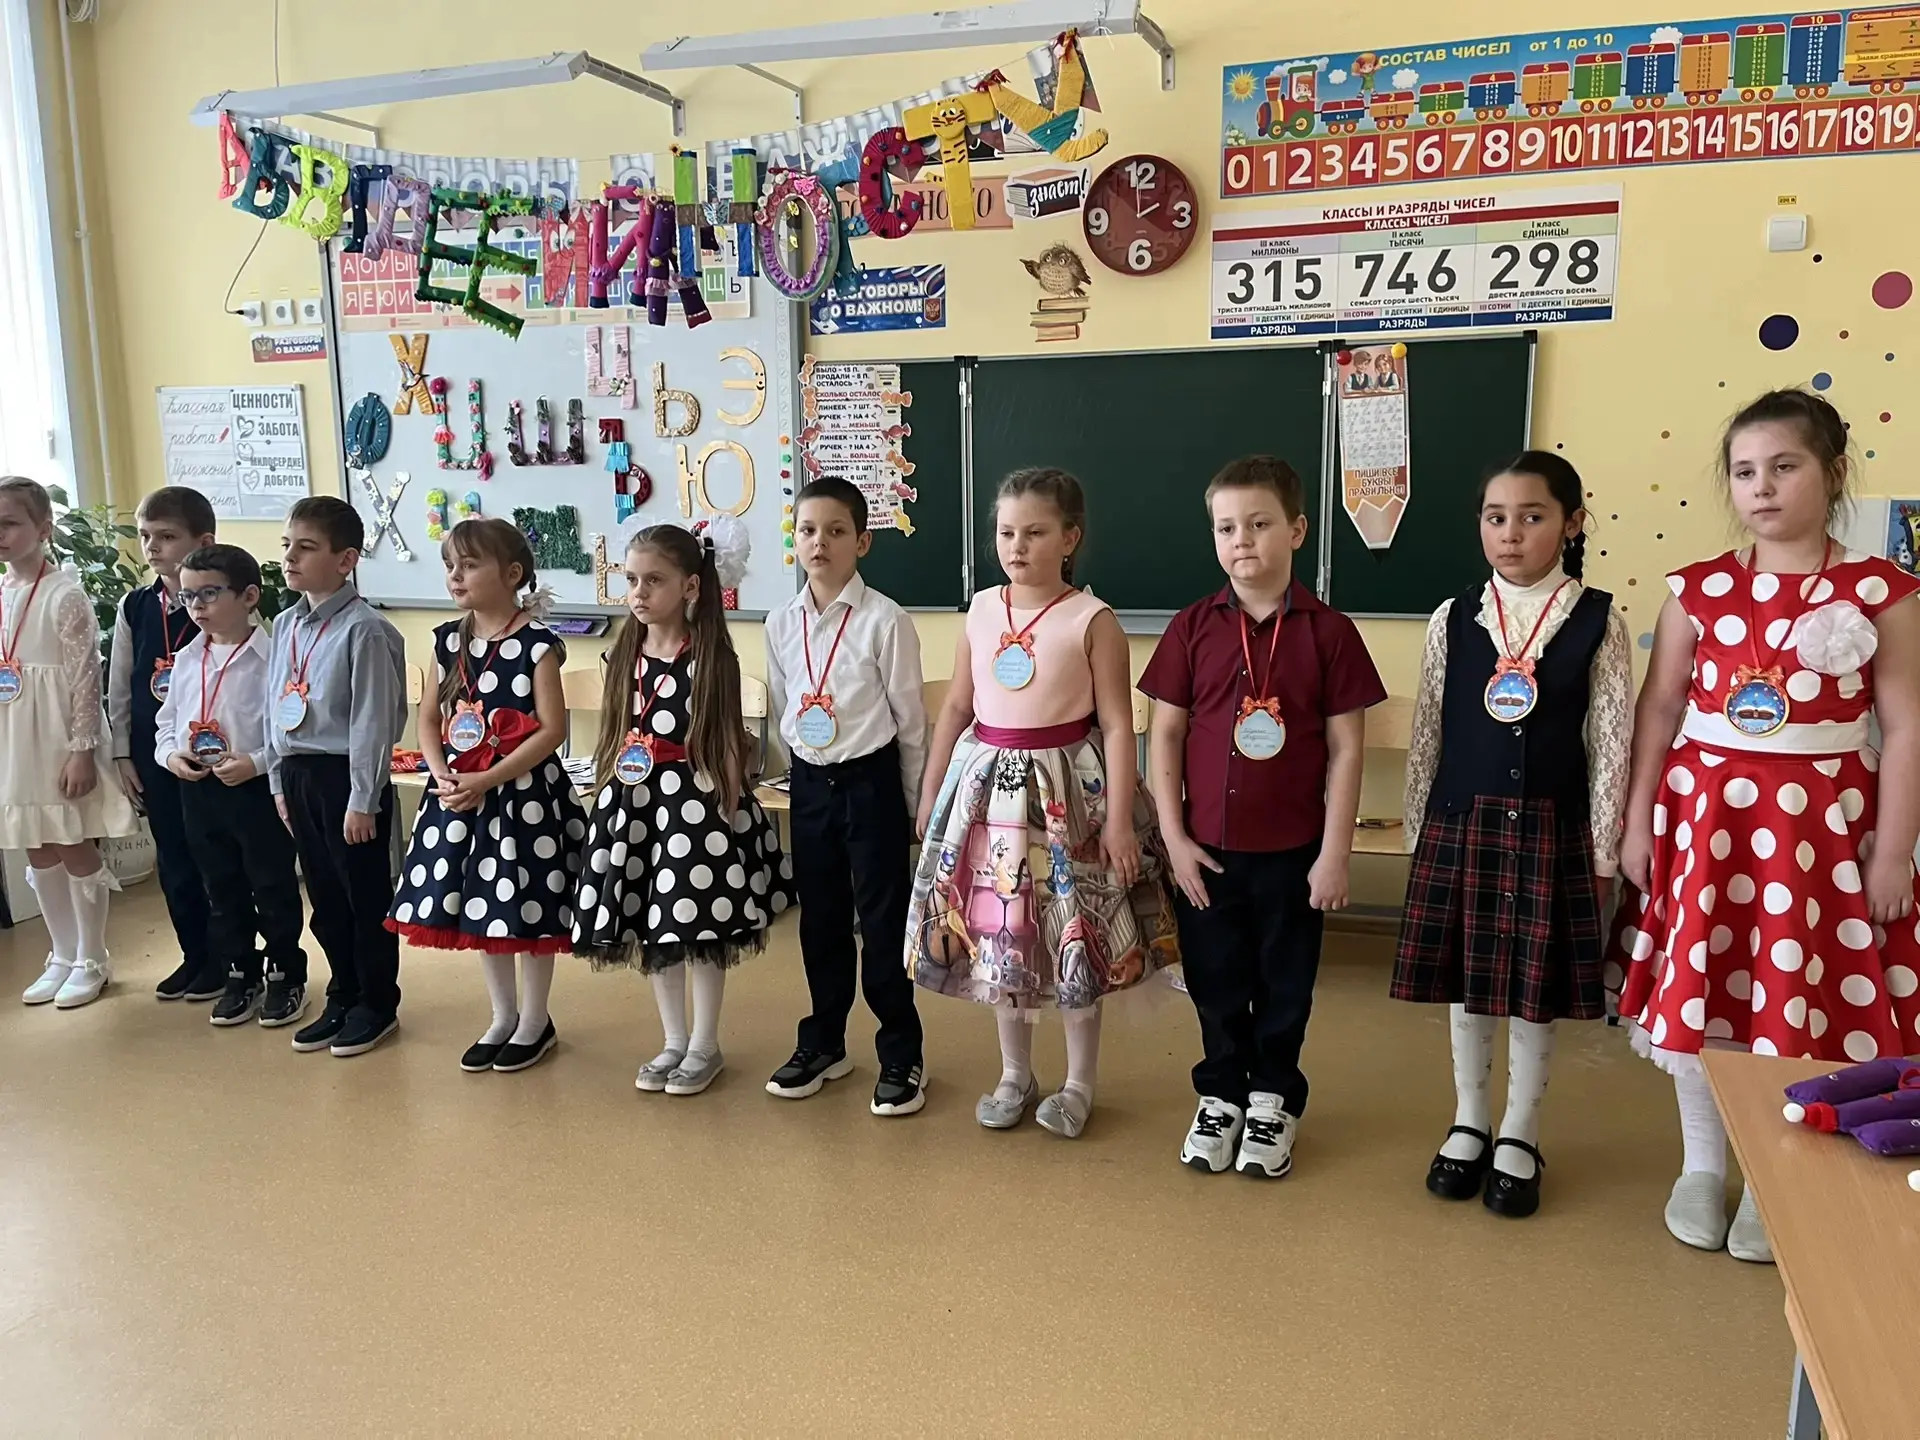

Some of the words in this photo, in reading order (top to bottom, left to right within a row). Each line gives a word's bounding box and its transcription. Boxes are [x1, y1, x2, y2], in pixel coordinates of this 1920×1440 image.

[1811, 16, 1823, 24] 10
[1757, 26, 1764, 34] 9
[1702, 34, 1709, 43] 8
[1379, 49, 1446, 67] СОСТАВ
[1452, 42, 1511, 59] ЧИСЕЛ
[1529, 41, 1548, 52] от
[1553, 38, 1560, 51] 1
[1567, 37, 1587, 50] до
[1594, 33, 1613, 46] 10
[1648, 45, 1655, 53] 7
[1227, 154, 1250, 189] 0
[1263, 151, 1278, 187] 1
[1289, 148, 1311, 185] 2
[1320, 144, 1343, 182] 3
[1350, 142, 1376, 179] 4
[1384, 139, 1408, 177] 5
[1416, 135, 1441, 173] 6
[1451, 133, 1475, 171] 7
[1483, 129, 1510, 168] 8
[1518, 126, 1545, 166] 9
[1551, 124, 1582, 163] 10
[1587, 121, 1618, 160] 11
[1622, 119, 1653, 158] 12
[1657, 117, 1689, 156] 13
[1693, 115, 1725, 154] 14
[1729, 112, 1762, 152] 15
[1766, 110, 1799, 149] 16
[1802, 108, 1838, 148] 17
[1840, 105, 1875, 145] 18
[1878, 103, 1914, 143] 19
[1125, 161, 1156, 190] 12
[757, 166, 840, 301] О
[859, 126, 930, 239] С
[903, 91, 997, 231] Т
[1322, 206, 1373, 220] КЛАССЫ
[1376, 206, 1385, 215] И
[1388, 200, 1450, 215] РАЗРЯДЫ
[1453, 197, 1496, 210] ЧИСЕЛ
[1088, 207, 1109, 235] 9
[1172, 201, 1191, 228] 3
[1365, 217, 1410, 230] КЛАССЫ
[1412, 215, 1449, 227] ЧИСЕЛ
[1536, 220, 1561, 228] класс
[1399, 230, 1422, 238] класс
[1522, 228, 1569, 239] ЕДИНИЦЫ
[1269, 239, 1290, 247] класс
[1389, 238, 1424, 248] ТЫСЯЧИ
[1128, 239, 1152, 270] 6
[1251, 247, 1299, 257] МИЛЛИОНЫ
[343, 259, 355, 274] А
[360, 258, 372, 273] О
[395, 256, 409, 271] Ы
[1489, 239, 1599, 290] 298
[1354, 248, 1457, 299] 746
[707, 274, 724, 295] Щ
[1227, 257, 1322, 305] 315
[346, 292, 357, 308] Я
[379, 290, 394, 306] Ю
[1488, 292, 1517, 300] двести
[1519, 289, 1564, 298] девяносто
[1383, 298, 1406, 306] сорок
[1528, 300, 1562, 309] ДЕСЯТКИ
[1572, 297, 1610, 306] ЕДИНИЦЫ
[830, 306, 841, 317] О
[845, 299, 923, 317] ВАЖНОМ!
[1217, 307, 1242, 315] триста
[1244, 304, 1287, 313] пятнадцать
[1289, 302, 1331, 310] миллионов
[1390, 308, 1423, 317] ДЕСЯТКИ
[1433, 305, 1470, 314] ЕДИНИЦЫ
[1261, 315, 1292, 323] ДЕСЯТКИ
[1300, 313, 1334, 321] ЕДИНИЦЫ
[1515, 311, 1567, 322] РАЗРЯДЫ
[1379, 318, 1428, 329] РАЗРЯДЫ
[1250, 325, 1296, 335] РАЗРЯДЫ
[283, 345, 319, 353] ВАЖНОМ
[717, 347, 766, 426] Э
[232, 393, 293, 410] ЦЕННОСТИ
[653, 361, 700, 438] Ь
[258, 422, 299, 436] ЗАБОТА
[346, 392, 391, 465] Ф
[504, 397, 585, 467] Ш
[250, 457, 302, 468] МИЛОСЕРДИЕ
[1354, 469, 1380, 478] ПИШИ
[1382, 467, 1398, 476] ВСЕ
[264, 475, 305, 487] ДОБРОТА
[676, 440, 755, 518] Ю
[1362, 478, 1391, 487] БУКВЫ
[356, 469, 411, 562] Х
